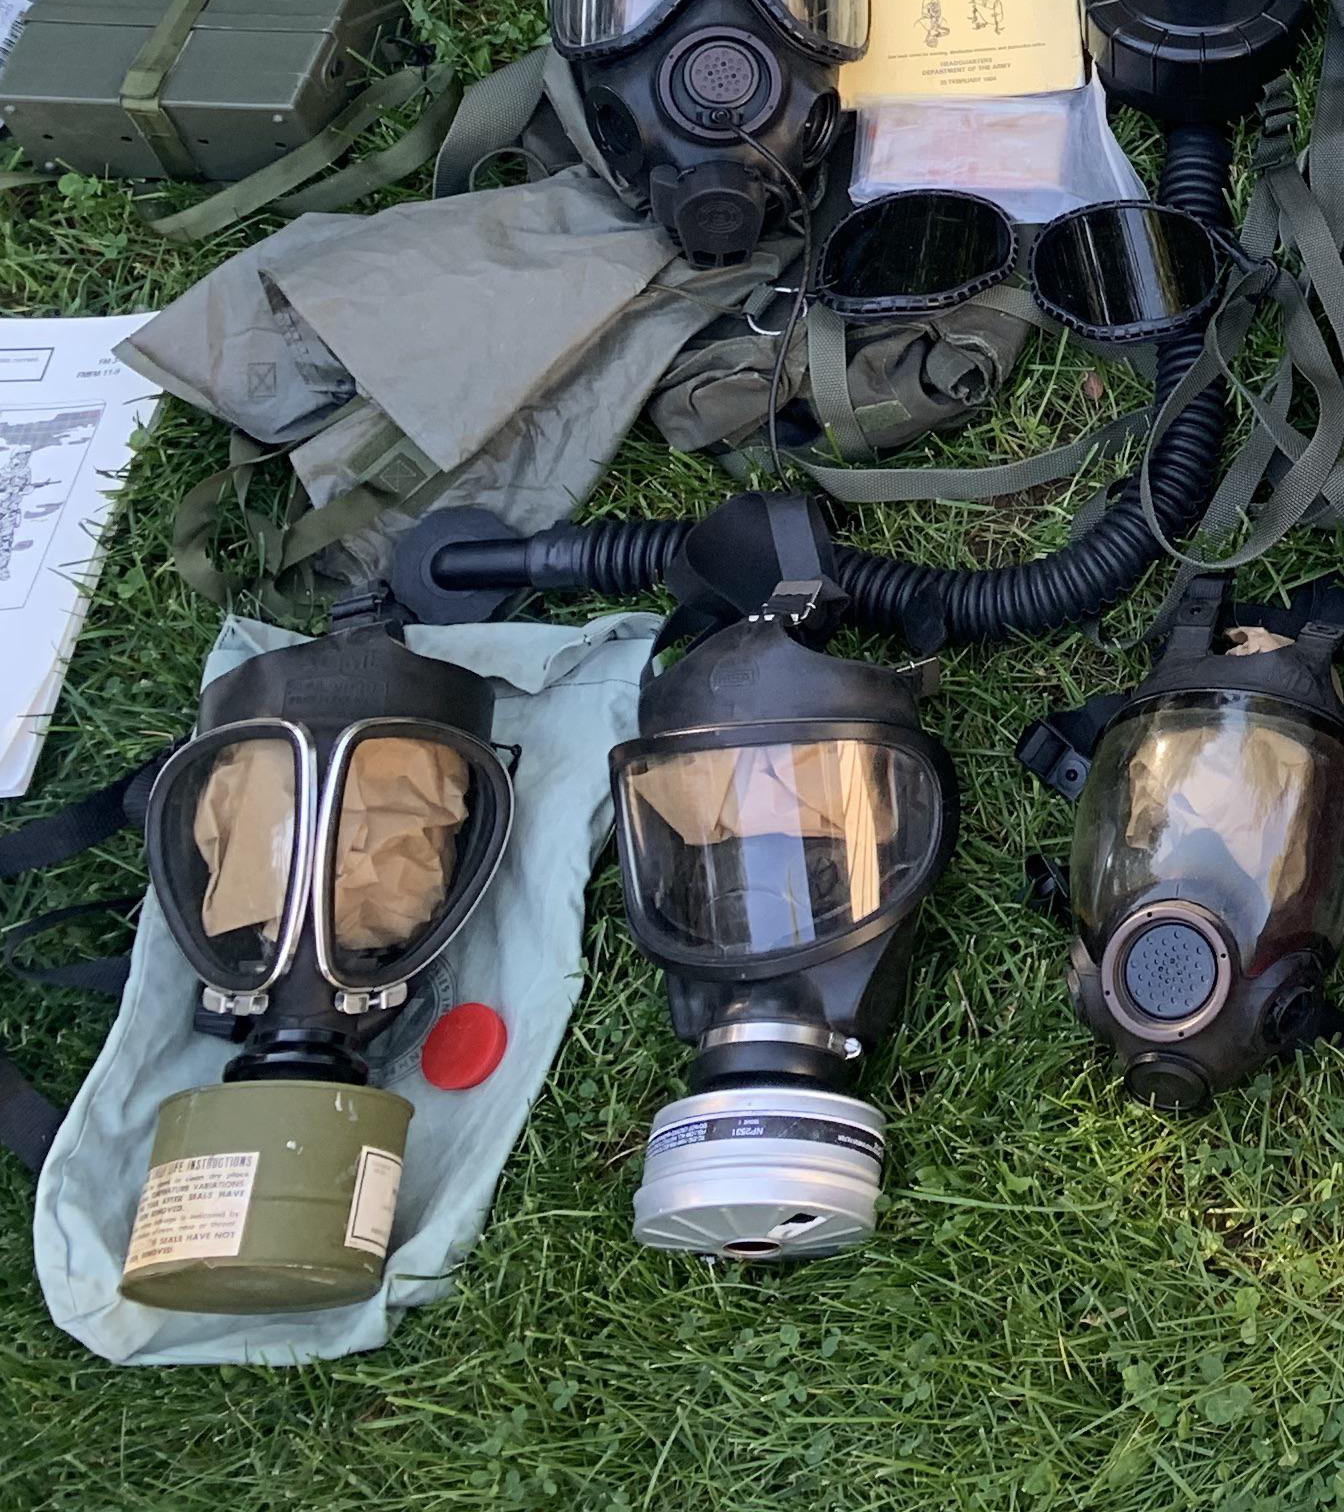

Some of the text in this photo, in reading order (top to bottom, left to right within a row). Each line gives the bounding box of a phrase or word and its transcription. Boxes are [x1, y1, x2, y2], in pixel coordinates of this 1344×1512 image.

[187, 1155, 253, 1171] INSTRUCTIONS
[193, 1180, 245, 1190] VARIATIONS
[219, 1189, 245, 1199] HAVE
[186, 1233, 211, 1242] HAVE
[214, 1230, 237, 1240] NOT
